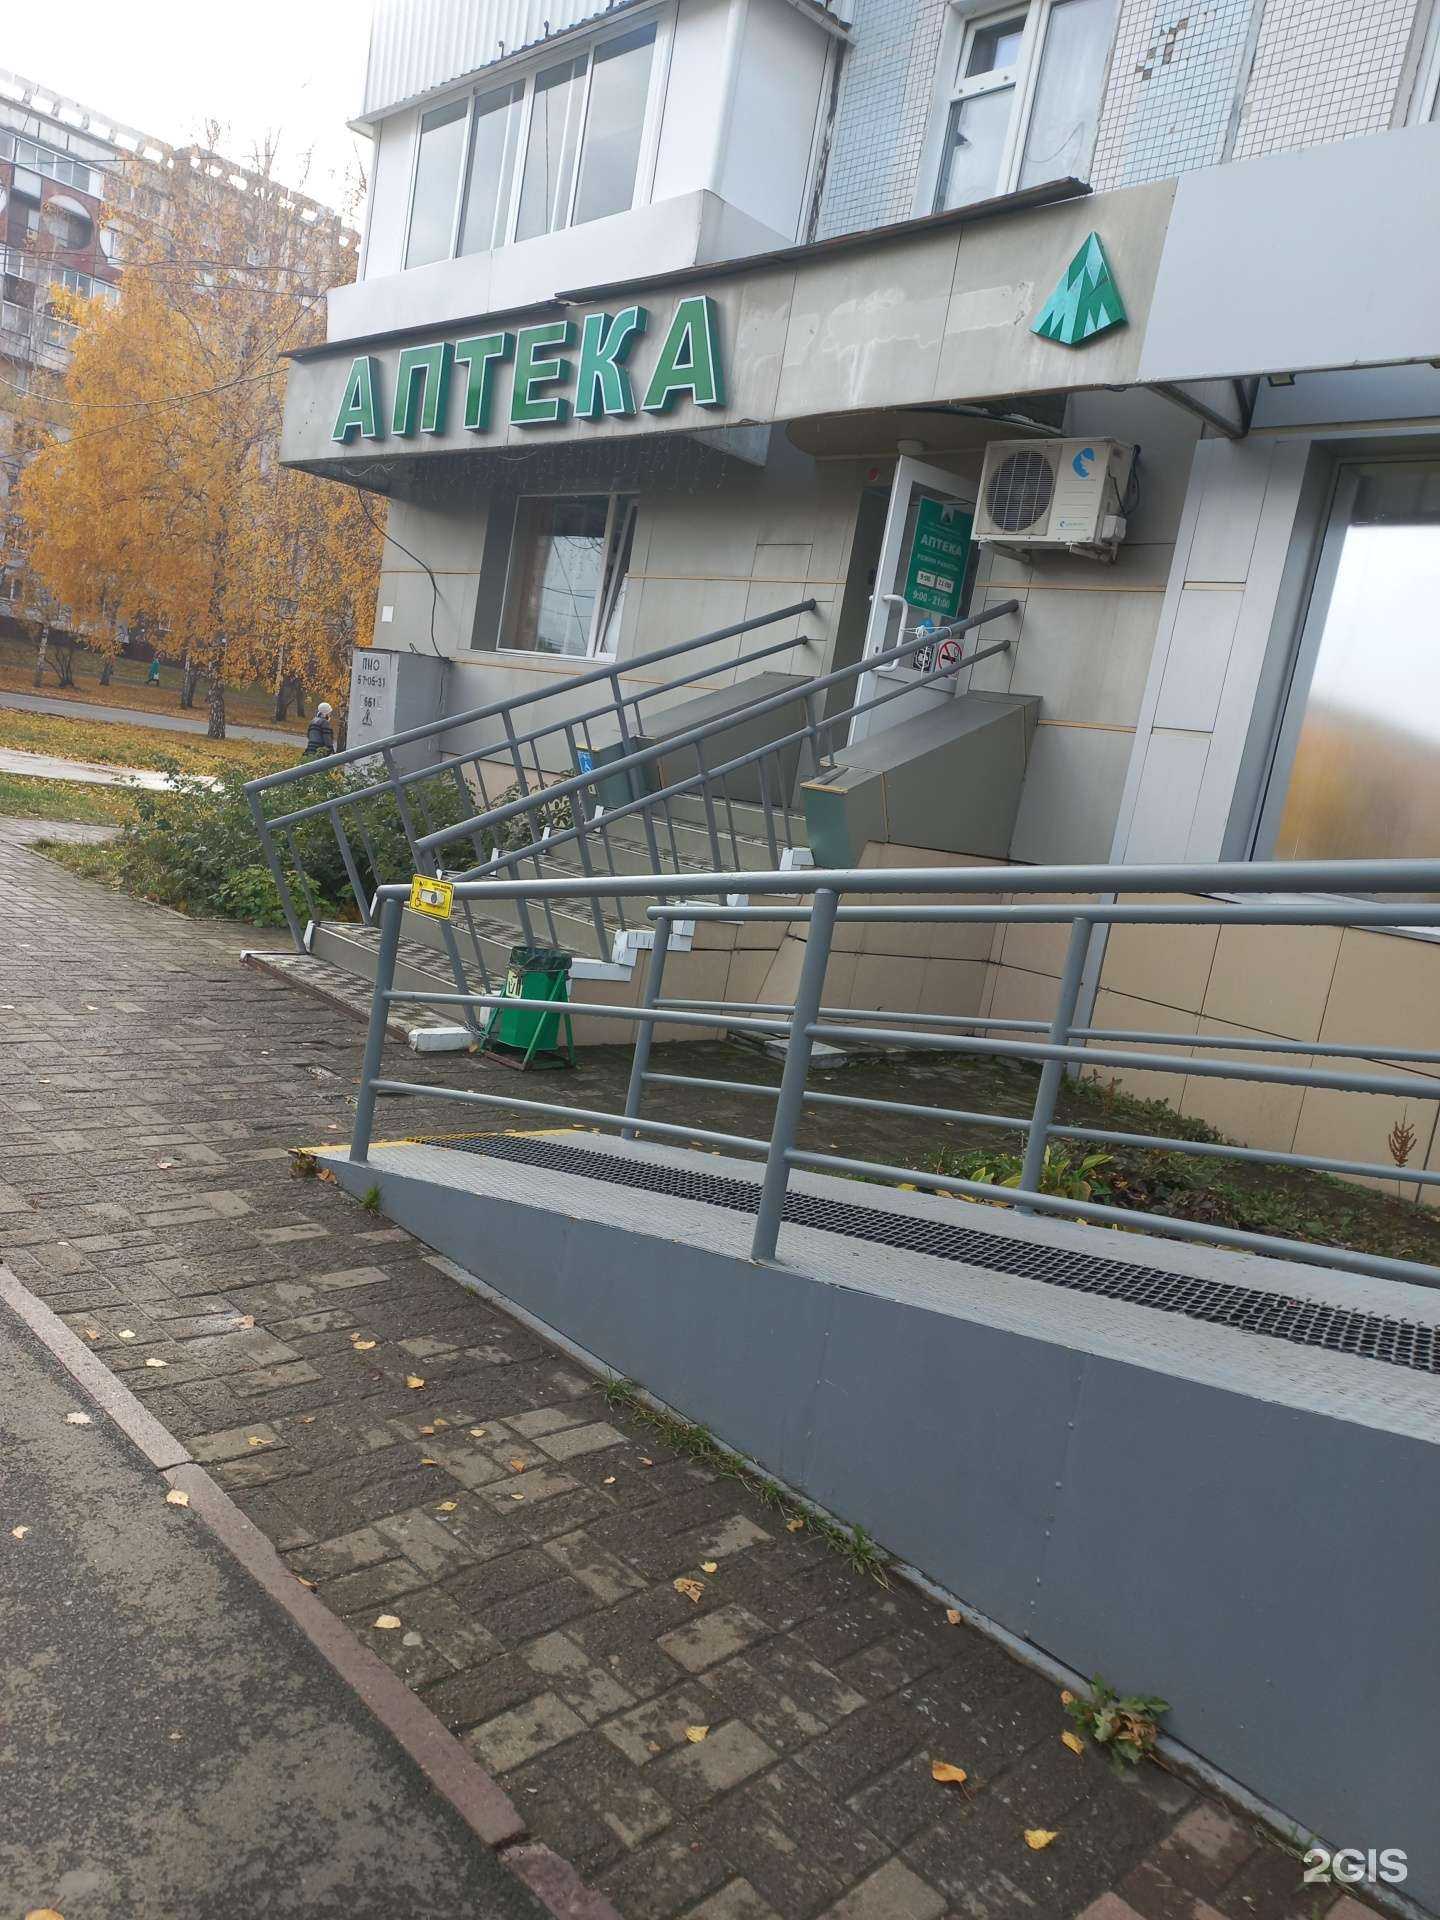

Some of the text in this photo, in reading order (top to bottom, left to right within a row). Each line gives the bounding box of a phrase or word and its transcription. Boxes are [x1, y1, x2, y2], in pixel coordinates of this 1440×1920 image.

[331, 295, 723, 444] АПТЕКА
[921, 534, 962, 556] АПТЕКА
[912, 589, 928, 602] 9:00
